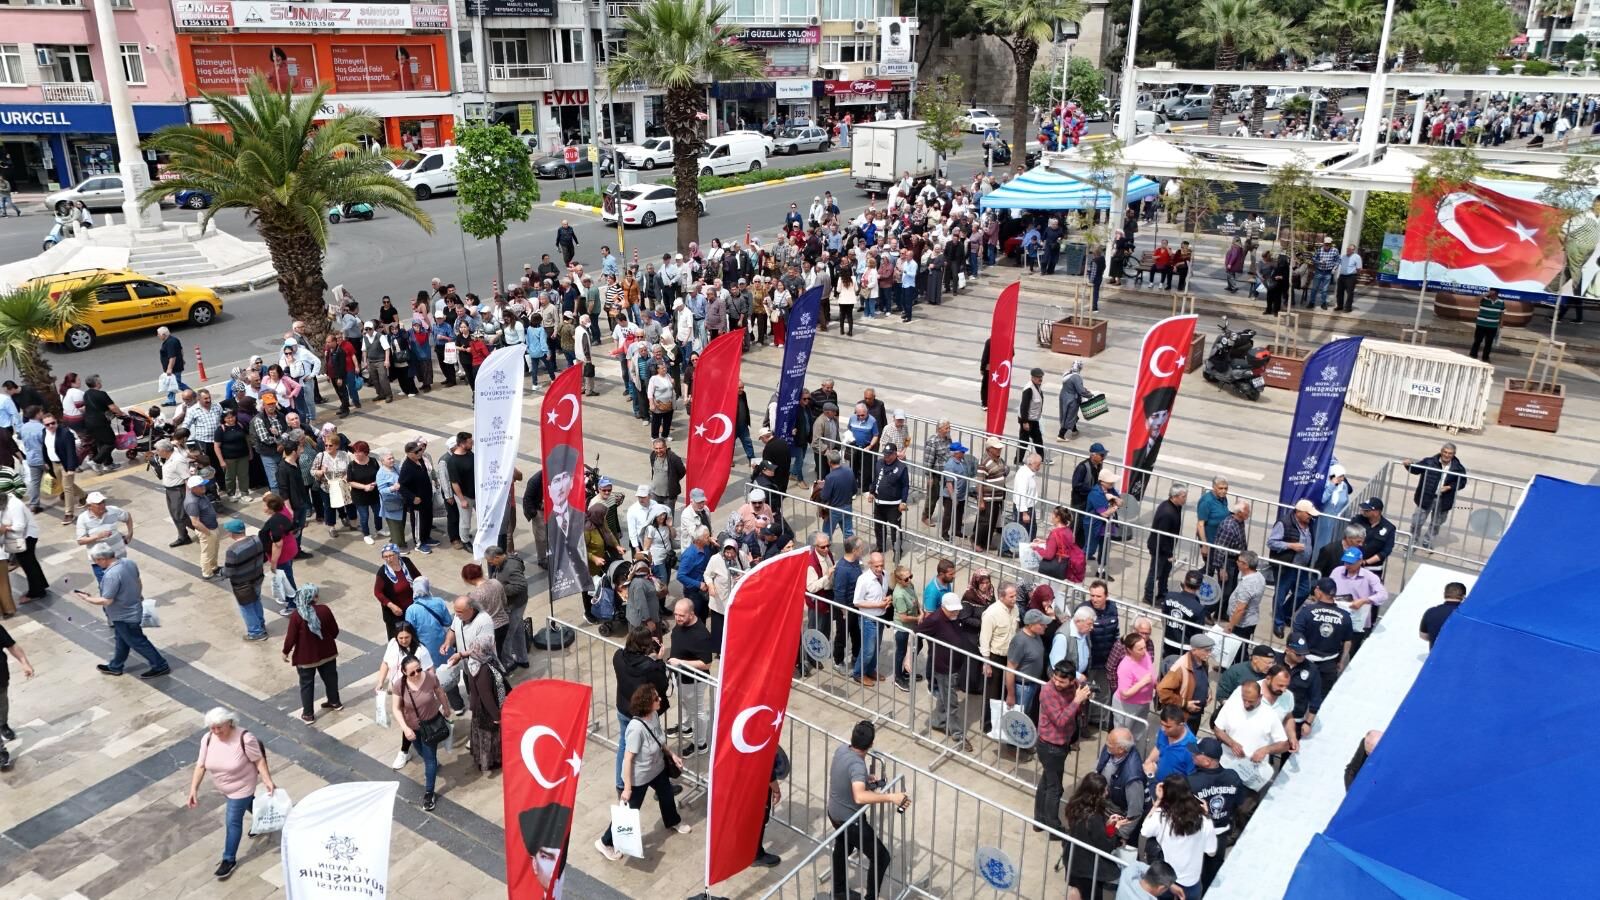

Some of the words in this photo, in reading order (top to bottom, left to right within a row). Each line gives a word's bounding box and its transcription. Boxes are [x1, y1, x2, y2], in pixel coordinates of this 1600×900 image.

[356, 18, 405, 27] KURSLARI
[750, 29, 786, 38] GÜZELLİK
[787, 30, 817, 38] SALONU
[195, 59, 232, 67] Bitmeyen
[333, 58, 365, 66] Bitmeyen
[197, 68, 212, 76] Hoş
[213, 67, 238, 75] Geldin
[335, 66, 347, 74] Hoş
[348, 65, 368, 73] Geldin
[544, 89, 589, 106] EVKU
[0, 112, 72, 125] URKCELL
[1313, 613, 1342, 625] ZABITA
